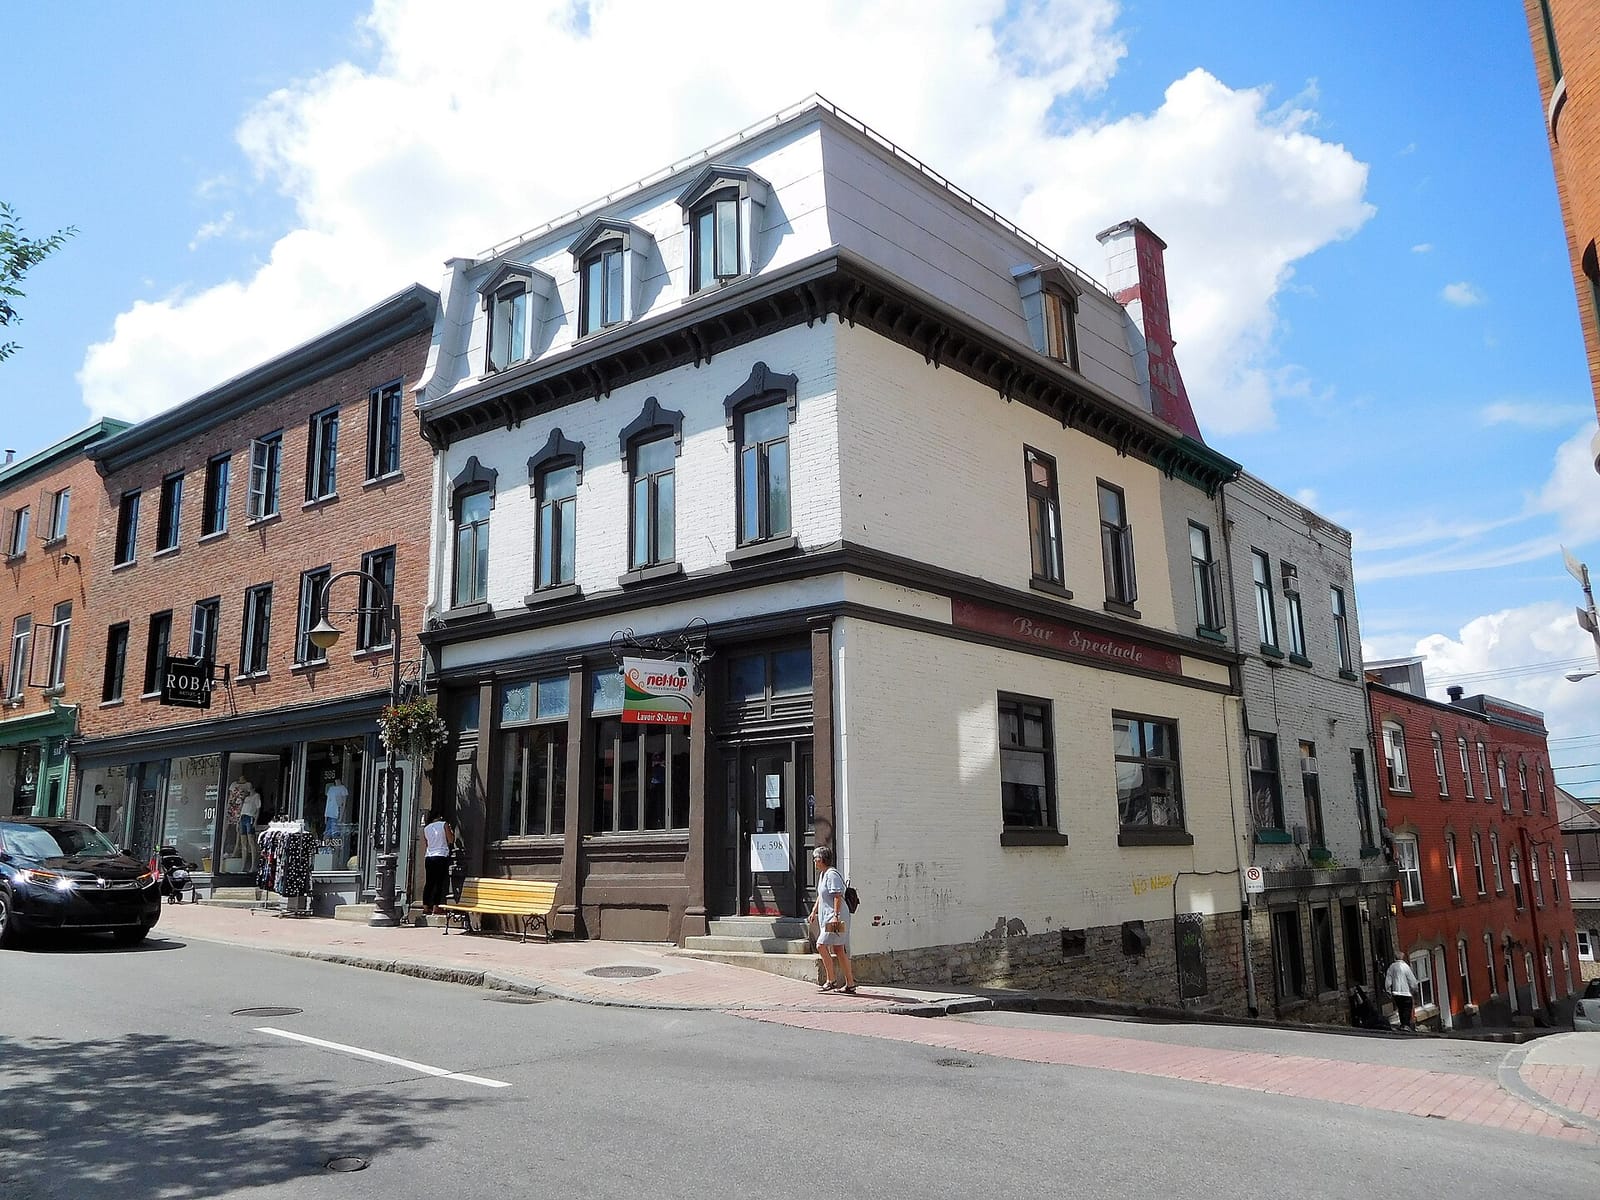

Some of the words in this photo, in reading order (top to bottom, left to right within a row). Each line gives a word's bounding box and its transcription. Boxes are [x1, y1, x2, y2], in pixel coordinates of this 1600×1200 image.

[1012, 616, 1054, 641] Bar
[1068, 630, 1143, 662] Spectacle
[166, 674, 210, 692] ROBA
[636, 711, 655, 721] Lavoir
[656, 712, 678, 722] St-Jean
[204, 807, 215, 820] 101
[756, 840, 766, 850] Le
[768, 840, 783, 850] 598
